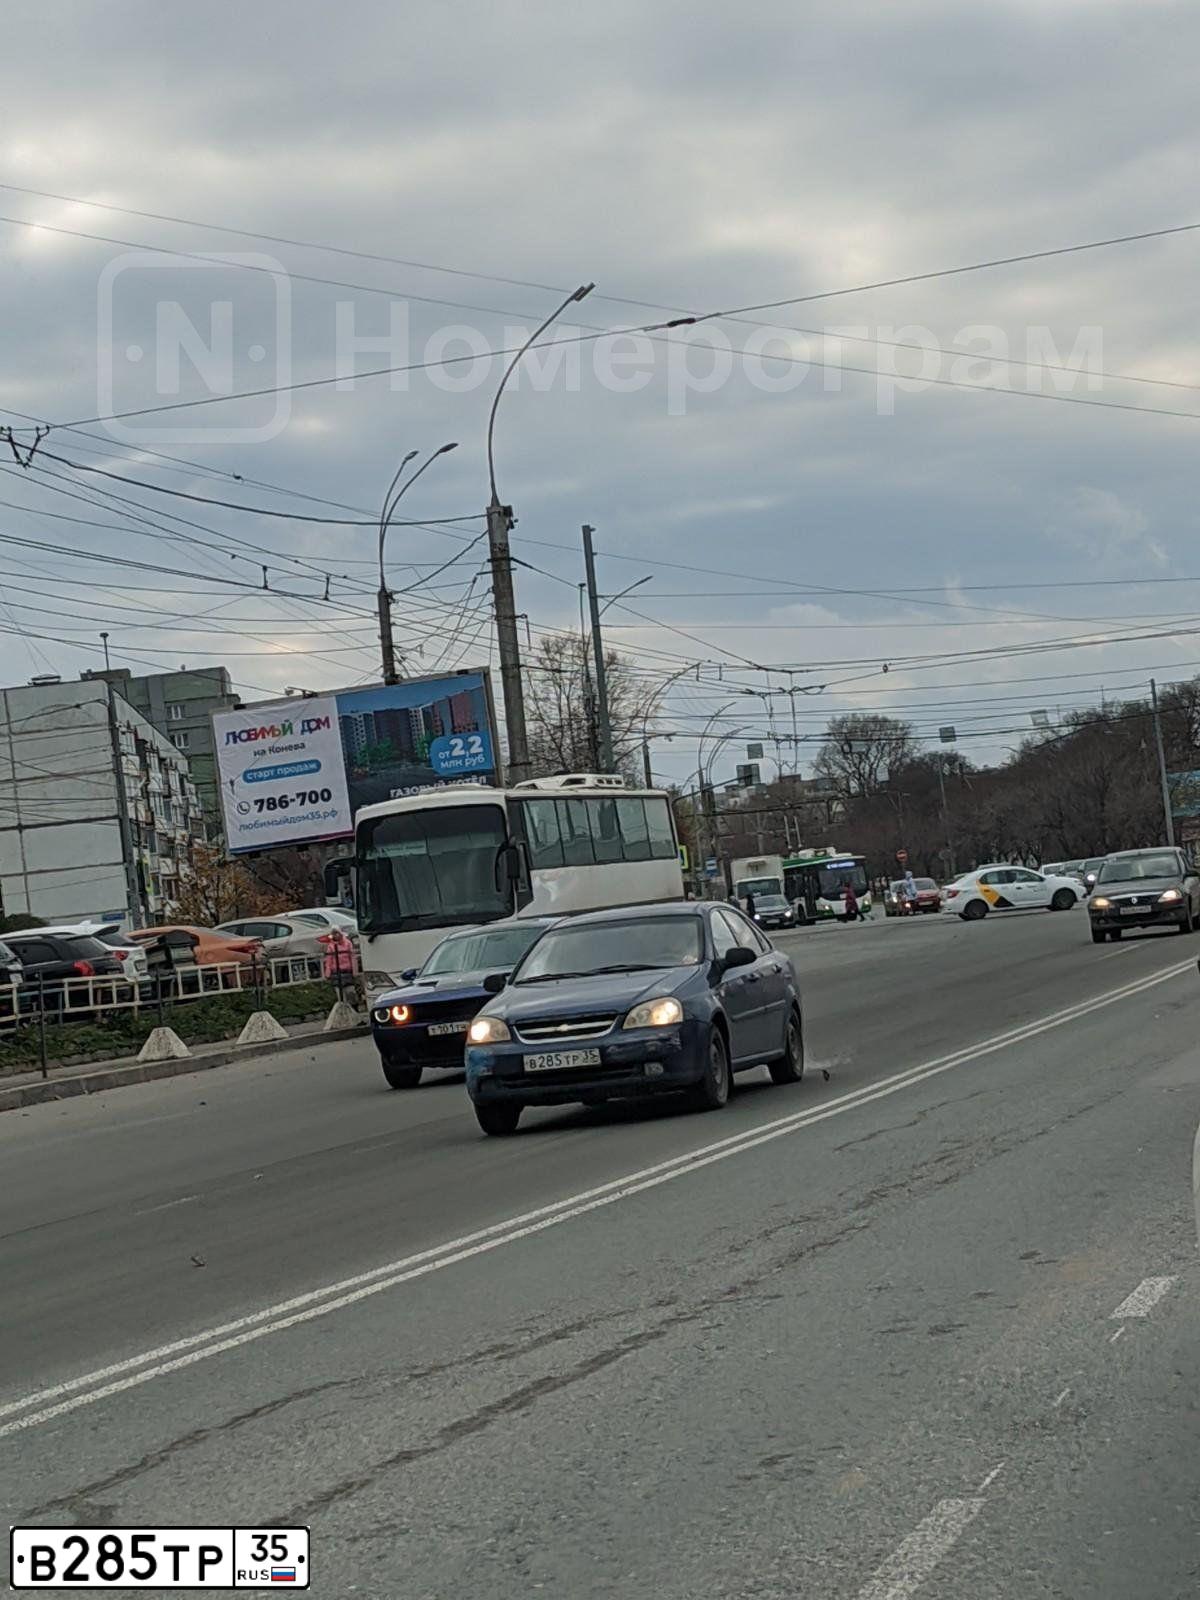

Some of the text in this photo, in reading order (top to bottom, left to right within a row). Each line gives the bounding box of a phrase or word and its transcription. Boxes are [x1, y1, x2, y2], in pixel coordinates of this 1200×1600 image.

[225, 716, 331, 745] ЛЮБИМЫЙ ДОМ
[253, 742, 306, 757] на Конева
[438, 750, 450, 760] от
[440, 753, 485, 769] млн руб
[247, 762, 319, 780] старт продаж
[253, 787, 333, 813] 786-700
[239, 808, 338, 832] любимыйдом35.рф
[583, 1050, 599, 1060] 35
